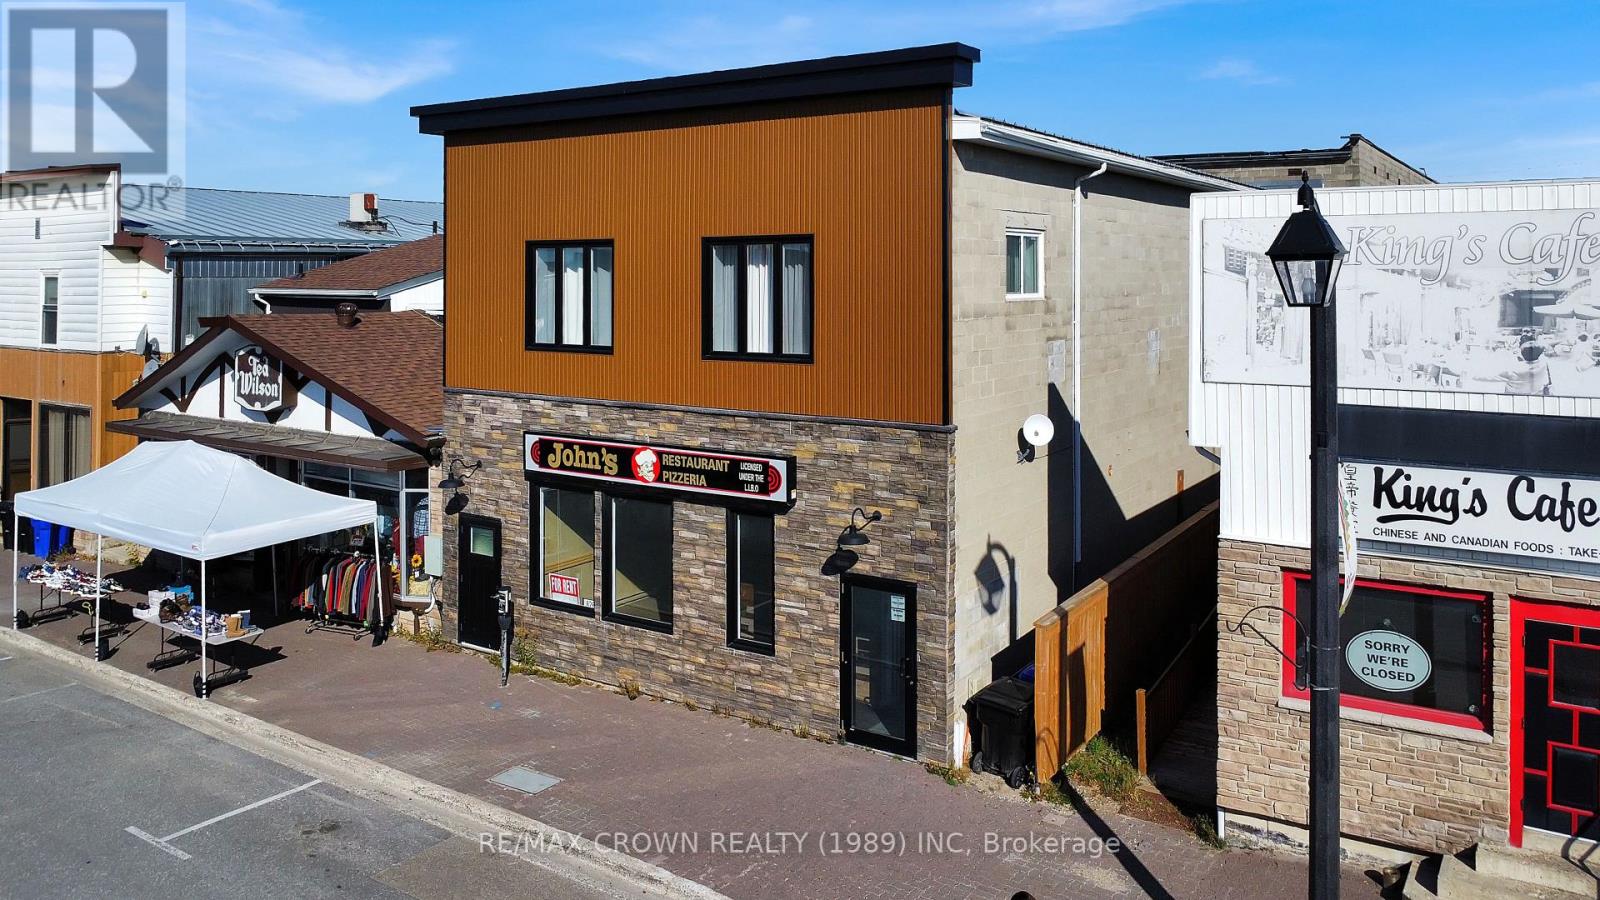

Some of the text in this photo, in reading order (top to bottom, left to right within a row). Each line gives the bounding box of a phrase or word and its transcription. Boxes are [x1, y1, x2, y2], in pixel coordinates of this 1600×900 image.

[1343, 212, 1600, 286] King's Cafe
[248, 355, 269, 377] Ted
[239, 371, 279, 397] Wilson
[547, 442, 618, 476] John's
[662, 453, 730, 472] RESTAURANT
[740, 461, 763, 472] LICENSED
[662, 470, 707, 487] PIZZERIA
[738, 472, 765, 483] UNDER THE
[1372, 466, 1600, 532] King's Cafe
[1372, 527, 1418, 540] CHINESE
[1423, 532, 1446, 543] AND
[1451, 535, 1509, 549] CANADIAN
[1514, 541, 1554, 554] FOODS
[551, 576, 577, 596] FOR RENT
[1364, 639, 1410, 654] SORRY
[1367, 653, 1409, 668] WE'RE
[1361, 666, 1416, 682] CLOSED
